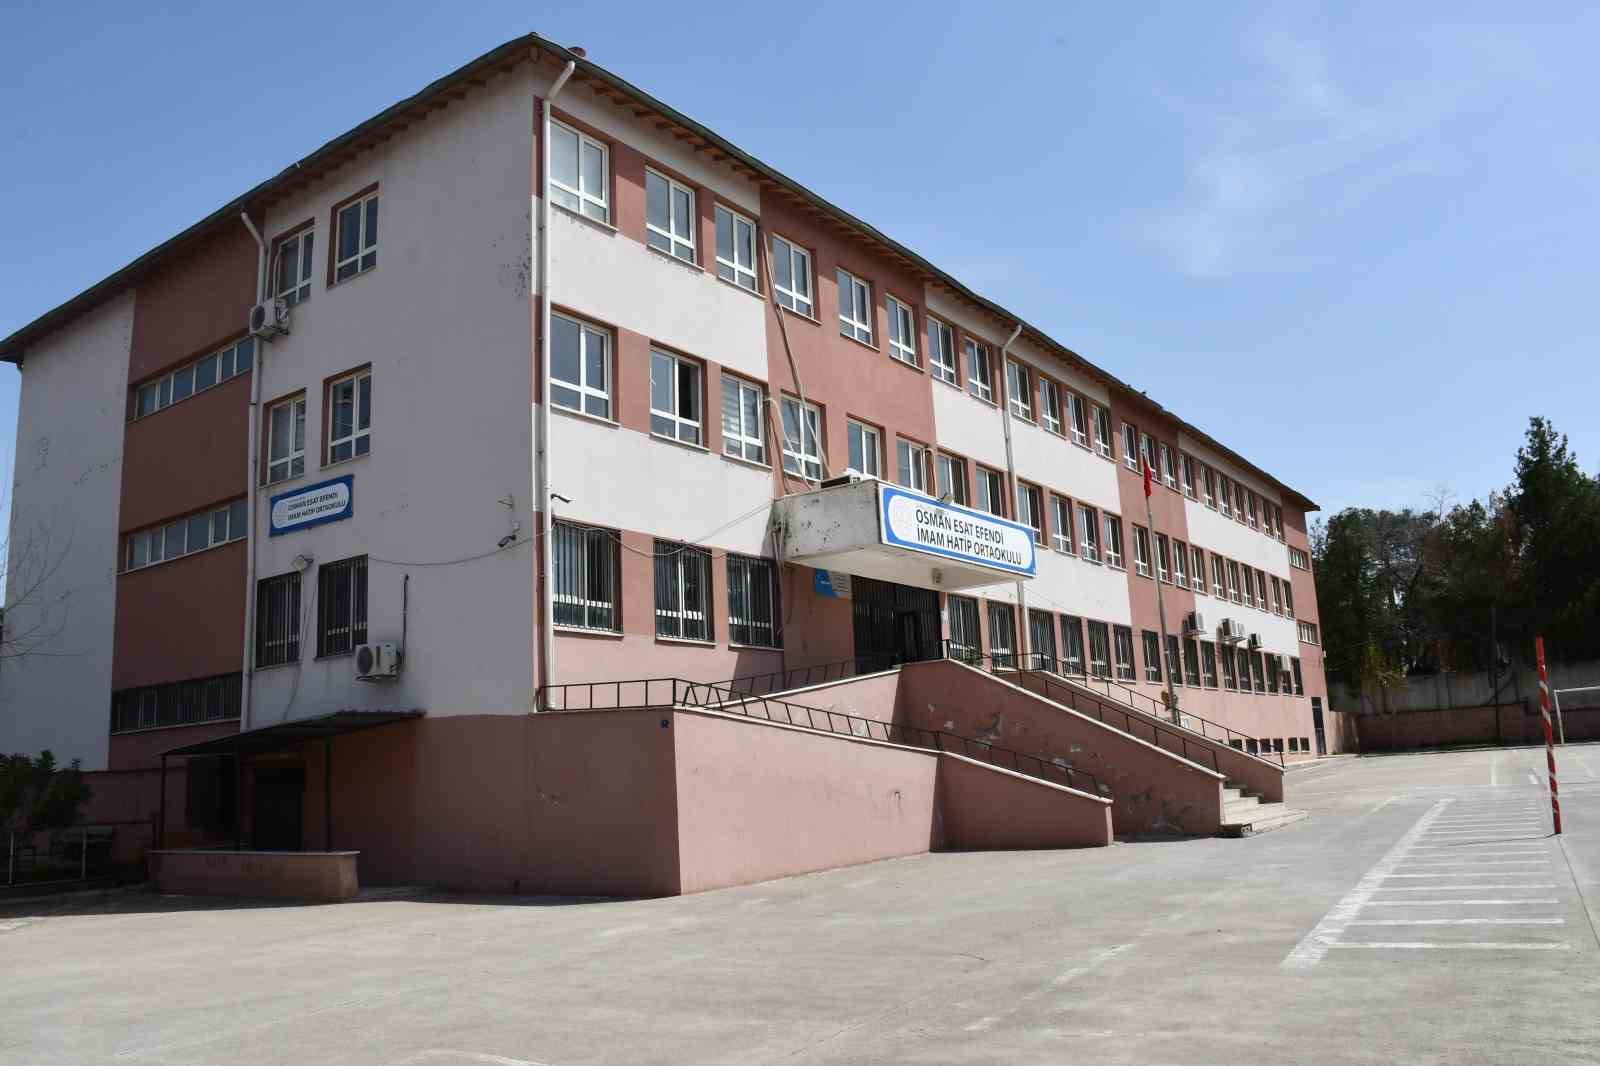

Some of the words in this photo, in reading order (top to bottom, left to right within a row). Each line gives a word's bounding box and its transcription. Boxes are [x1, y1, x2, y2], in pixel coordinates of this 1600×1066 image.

[916, 508, 952, 531] OSMAN
[954, 521, 974, 535] ESAT
[975, 525, 1004, 545] EFENDİ
[917, 524, 945, 547] İMAM
[947, 534, 972, 552] HATİP
[973, 542, 1022, 565] ORTAOKULU
